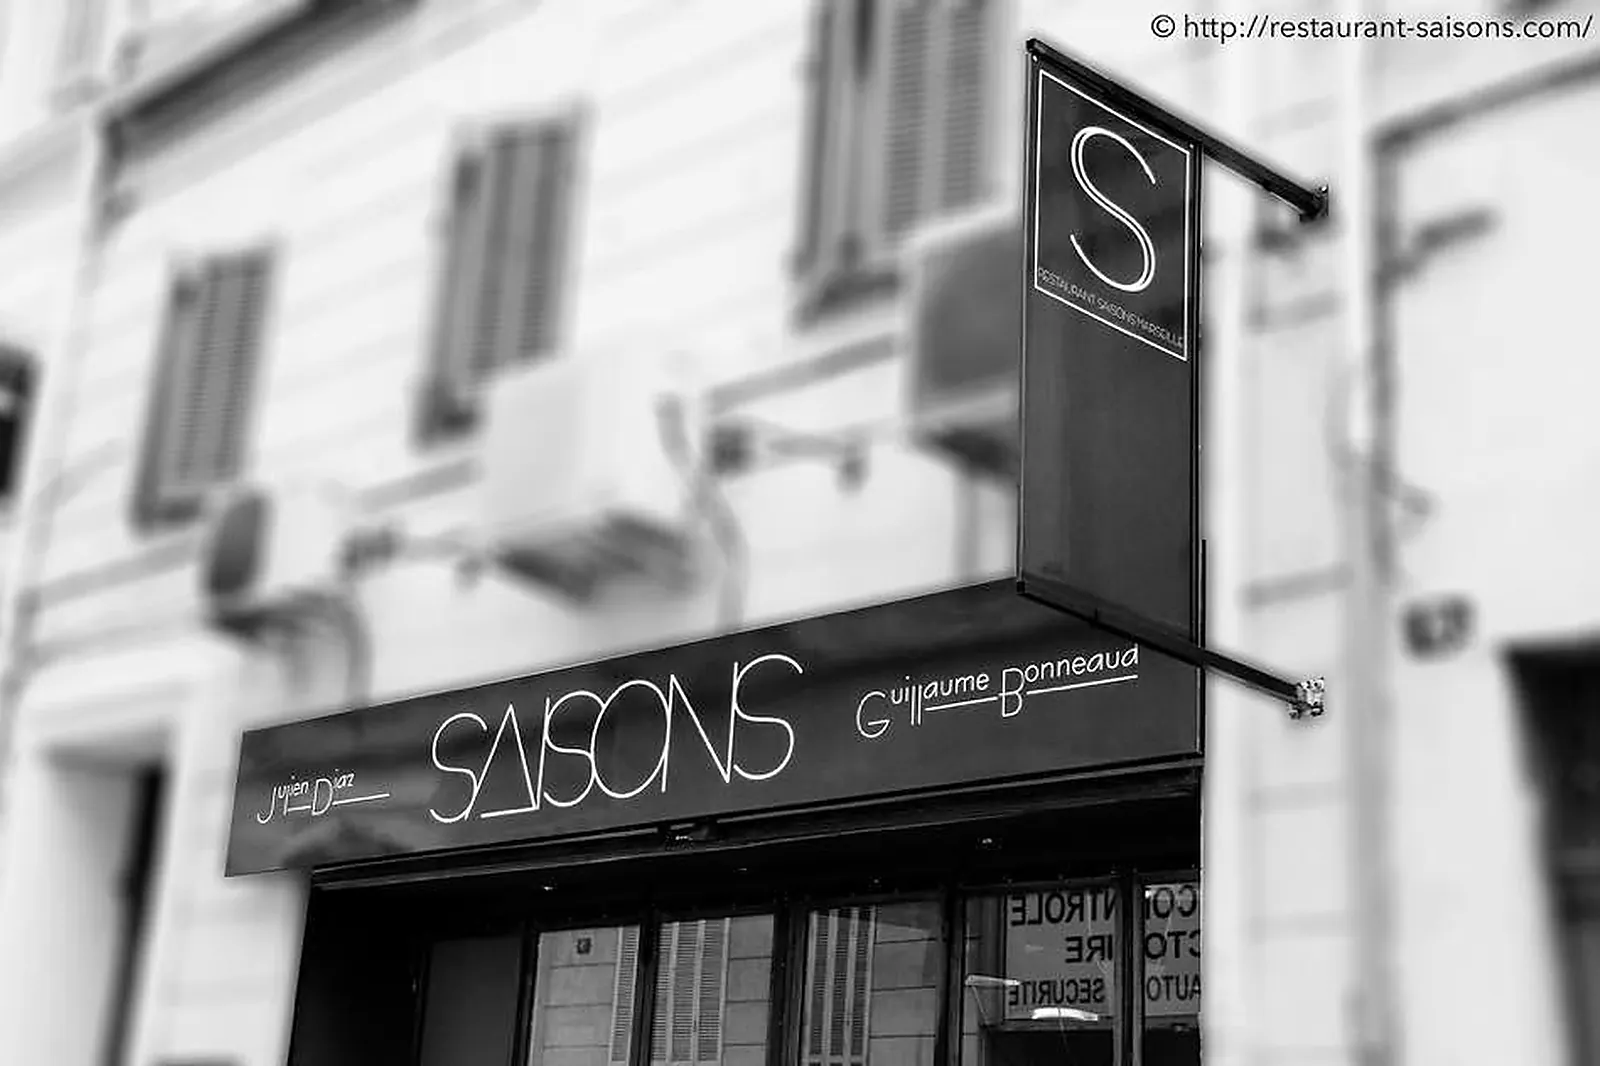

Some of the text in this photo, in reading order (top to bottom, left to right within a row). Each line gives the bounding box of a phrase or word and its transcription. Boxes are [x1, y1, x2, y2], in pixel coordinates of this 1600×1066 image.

[1070, 126, 1156, 292] S
[430, 654, 803, 823] SAISONS
[856, 643, 1139, 738] Guillaume Bonneaud
[256, 768, 355, 824] Julien Diaz
